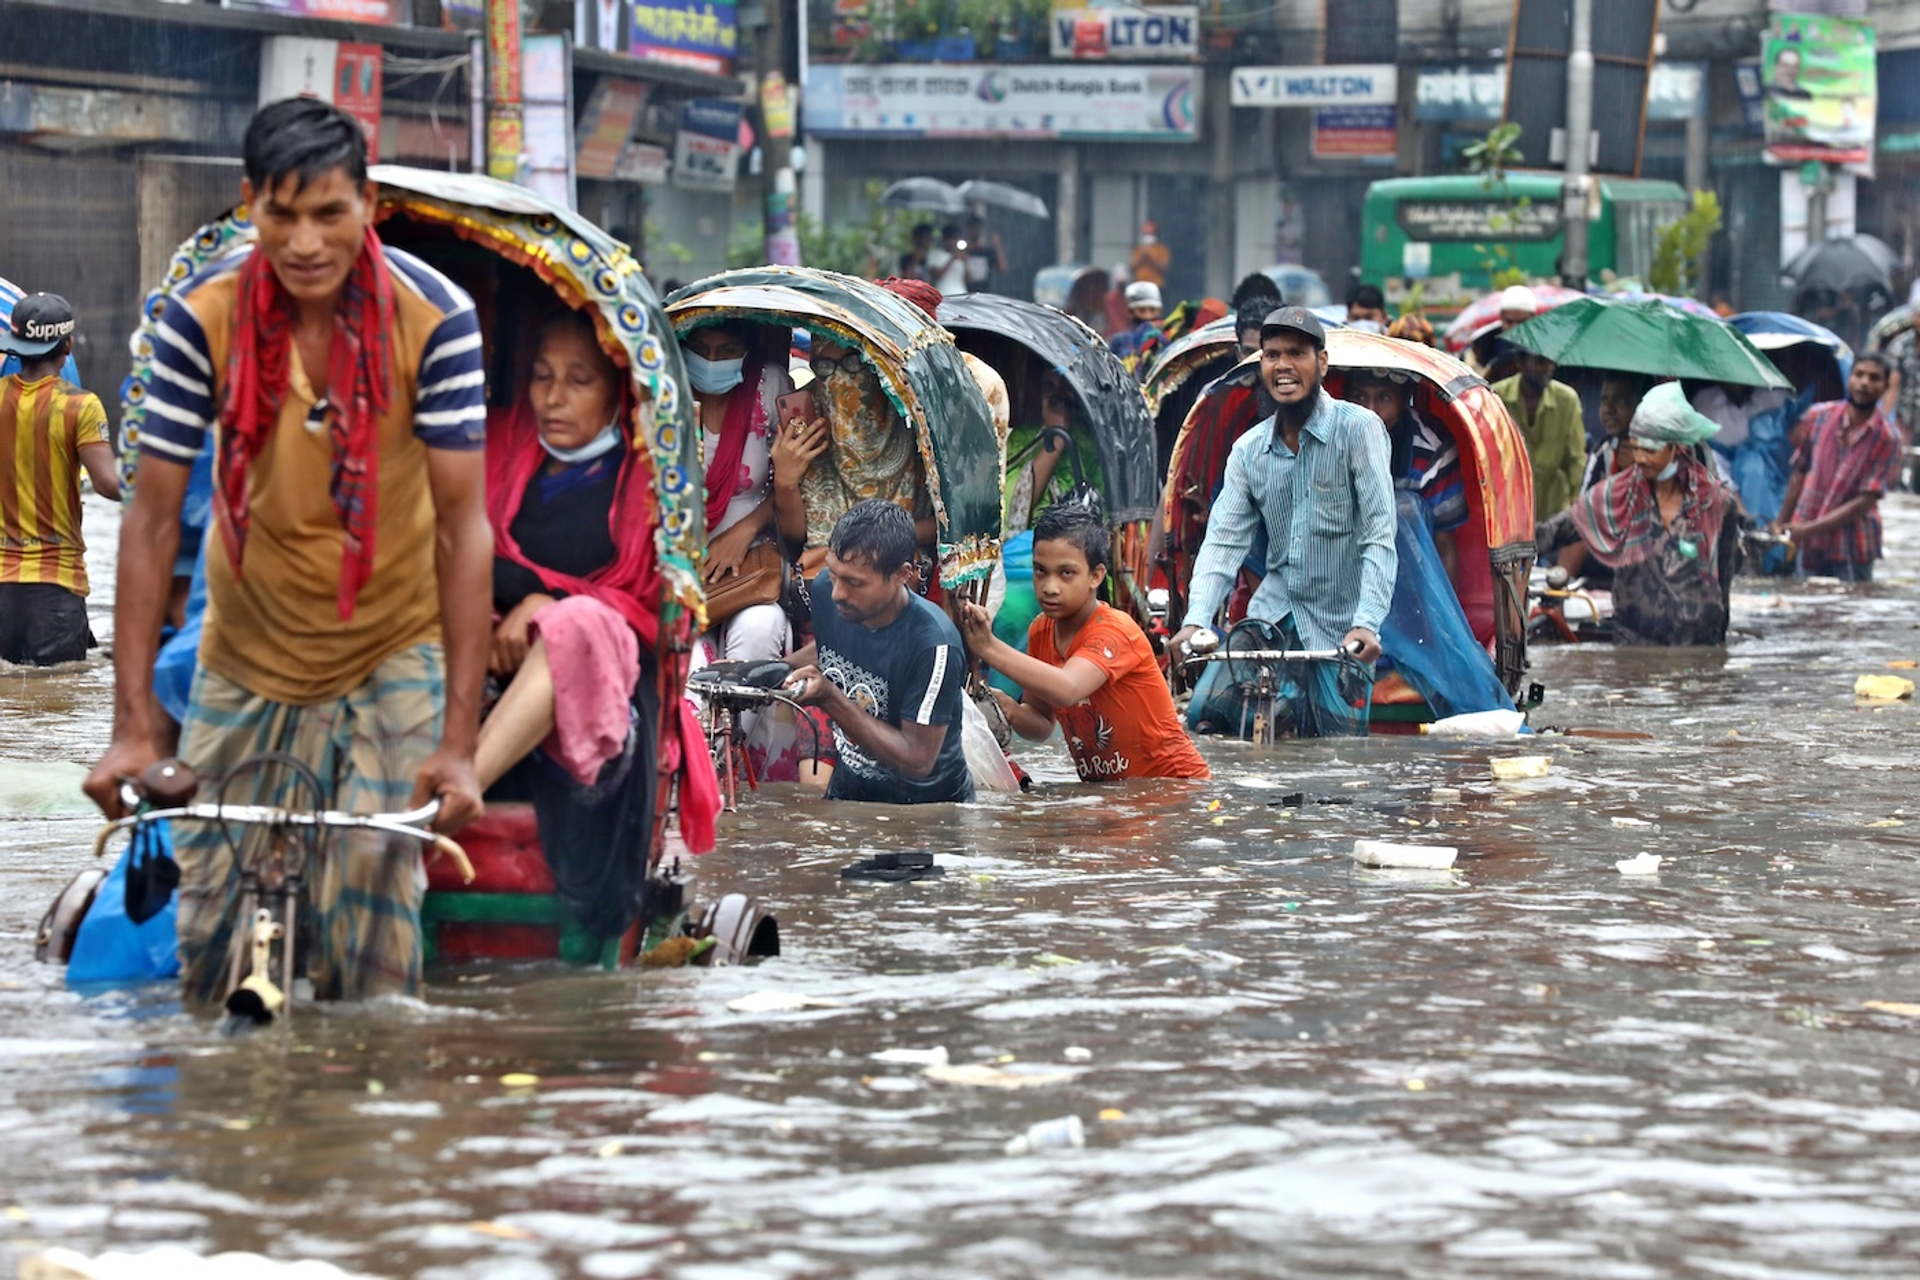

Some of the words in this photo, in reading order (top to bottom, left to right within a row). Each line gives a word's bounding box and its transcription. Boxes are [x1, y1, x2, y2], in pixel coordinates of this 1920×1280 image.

[1058, 17, 1190, 46] WLTON
[1285, 76, 1373, 95] WALTON
[25, 319, 75, 341] Suprem
[1091, 751, 1129, 775] Rock
